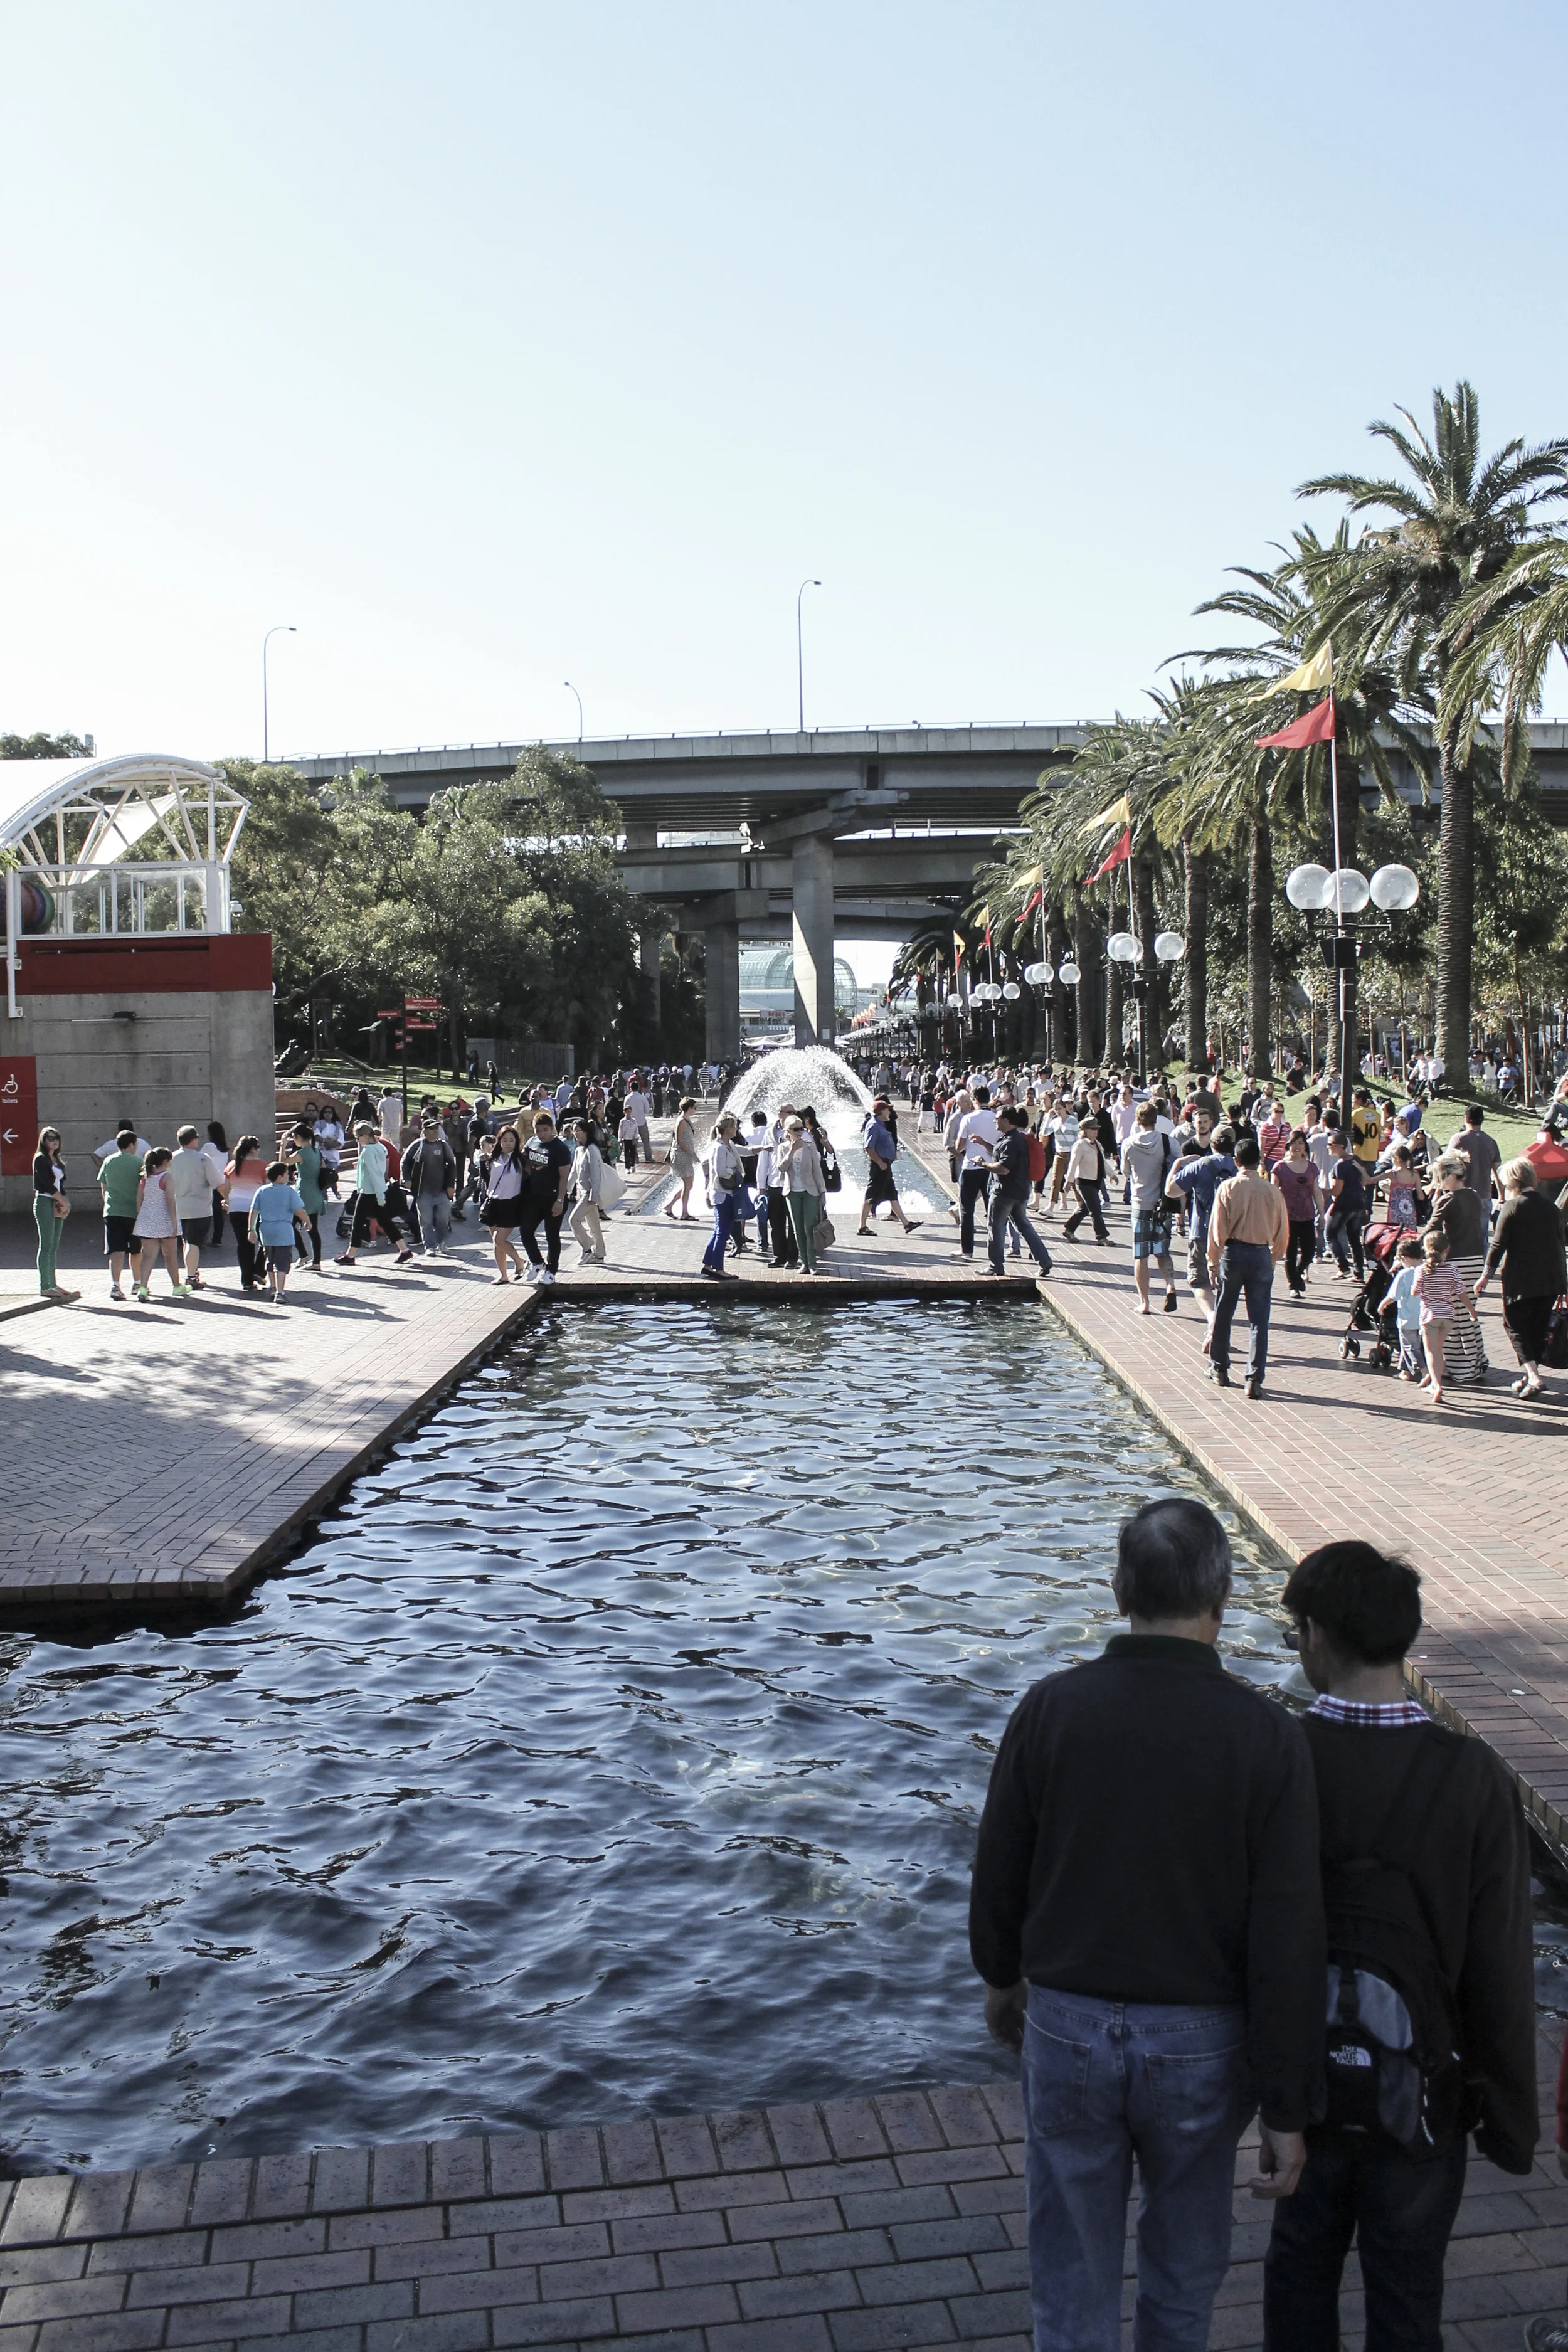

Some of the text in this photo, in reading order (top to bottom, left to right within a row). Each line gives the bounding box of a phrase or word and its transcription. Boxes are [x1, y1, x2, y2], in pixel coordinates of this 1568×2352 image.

[1364, 1123, 1377, 1139] 10
[529, 1150, 549, 1164] DIDAS
[1330, 2051, 1357, 2059] NORTH
